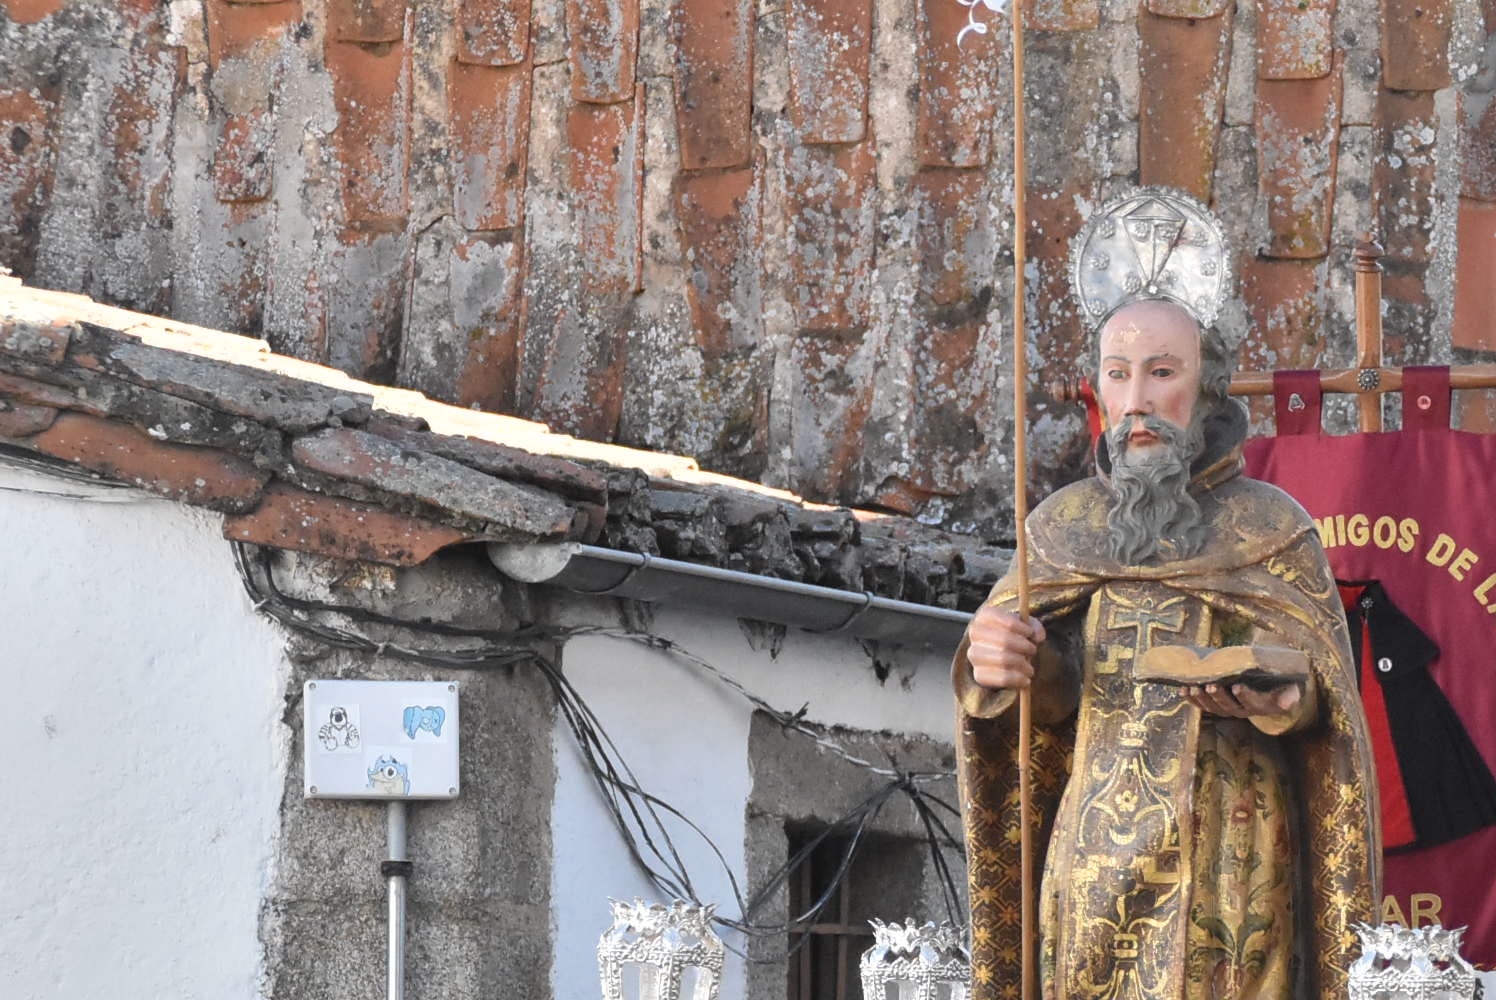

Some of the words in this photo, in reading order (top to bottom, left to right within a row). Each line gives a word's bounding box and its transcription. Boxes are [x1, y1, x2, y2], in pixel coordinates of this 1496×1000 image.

[1312, 513, 1420, 553] MIGOS
[1425, 533, 1479, 582] DE
[1381, 893, 1442, 930] AR
